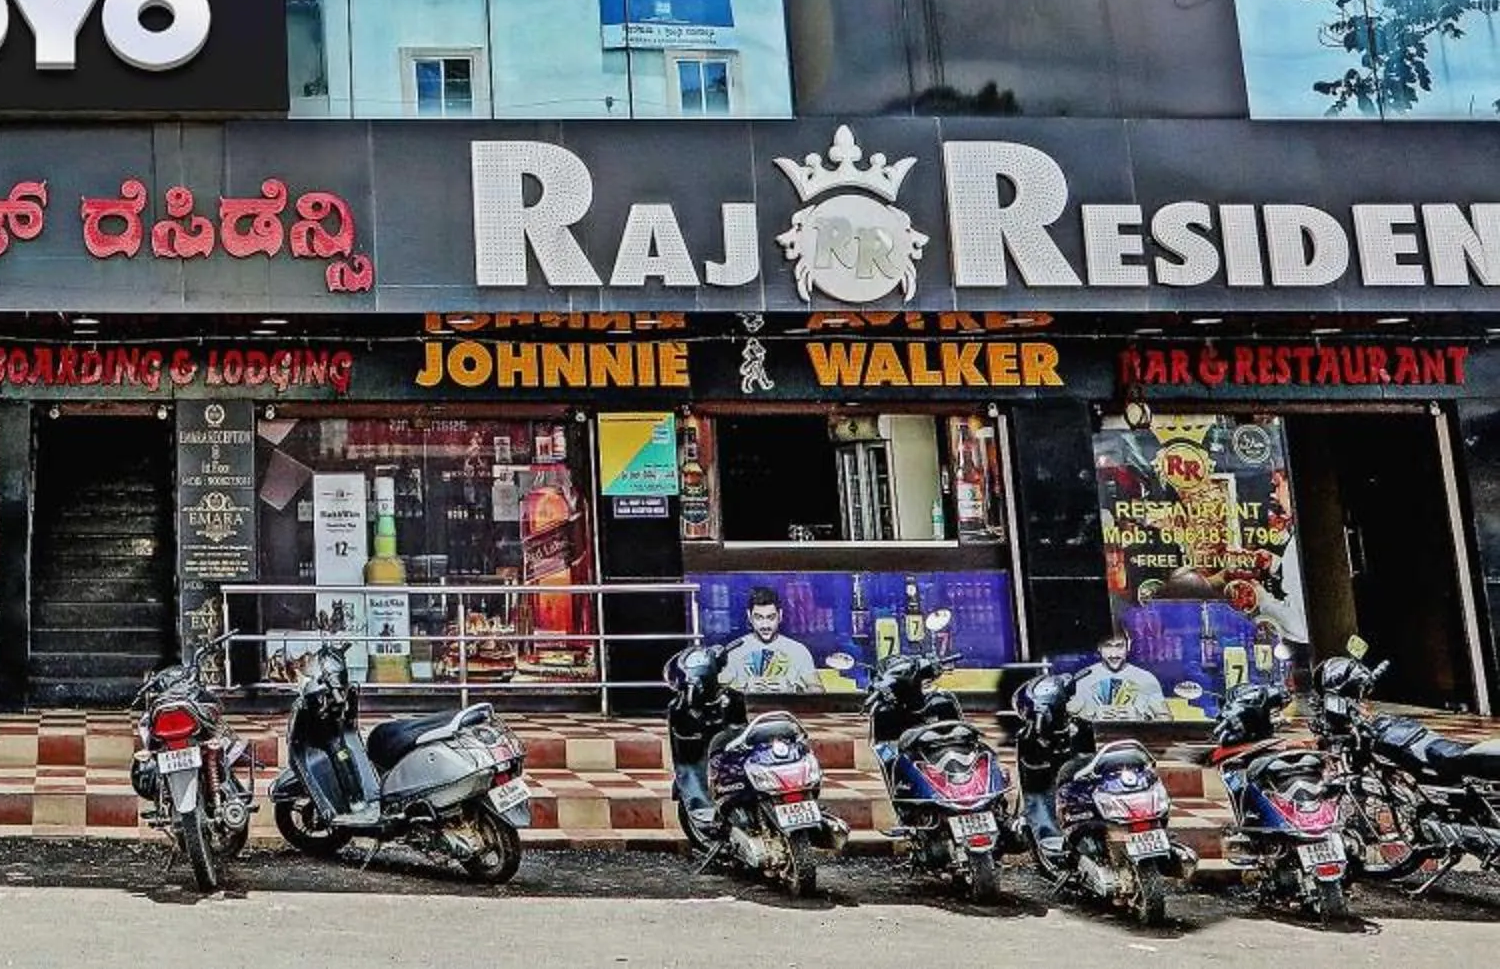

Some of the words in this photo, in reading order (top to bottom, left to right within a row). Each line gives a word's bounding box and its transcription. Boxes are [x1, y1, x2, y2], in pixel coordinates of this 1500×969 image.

[470, 140, 761, 287] RAJ
[205, 349, 353, 394] LODGING
[415, 339, 692, 388] JOHNNIE
[807, 341, 1064, 388] WALKER
[1234, 345, 1470, 385] RESTAURANT
[1166, 454, 1201, 482] RR
[189, 511, 244, 526] EMARA
[1115, 501, 1263, 521] RESTAURANT
[1102, 526, 1155, 545] Mob:
[334, 540, 349, 557] 12
[1137, 553, 1180, 569] FREE
[1182, 553, 1258, 569] DELIVERY
[883, 635, 896, 656] 7
[1232, 664, 1244, 682] 7
